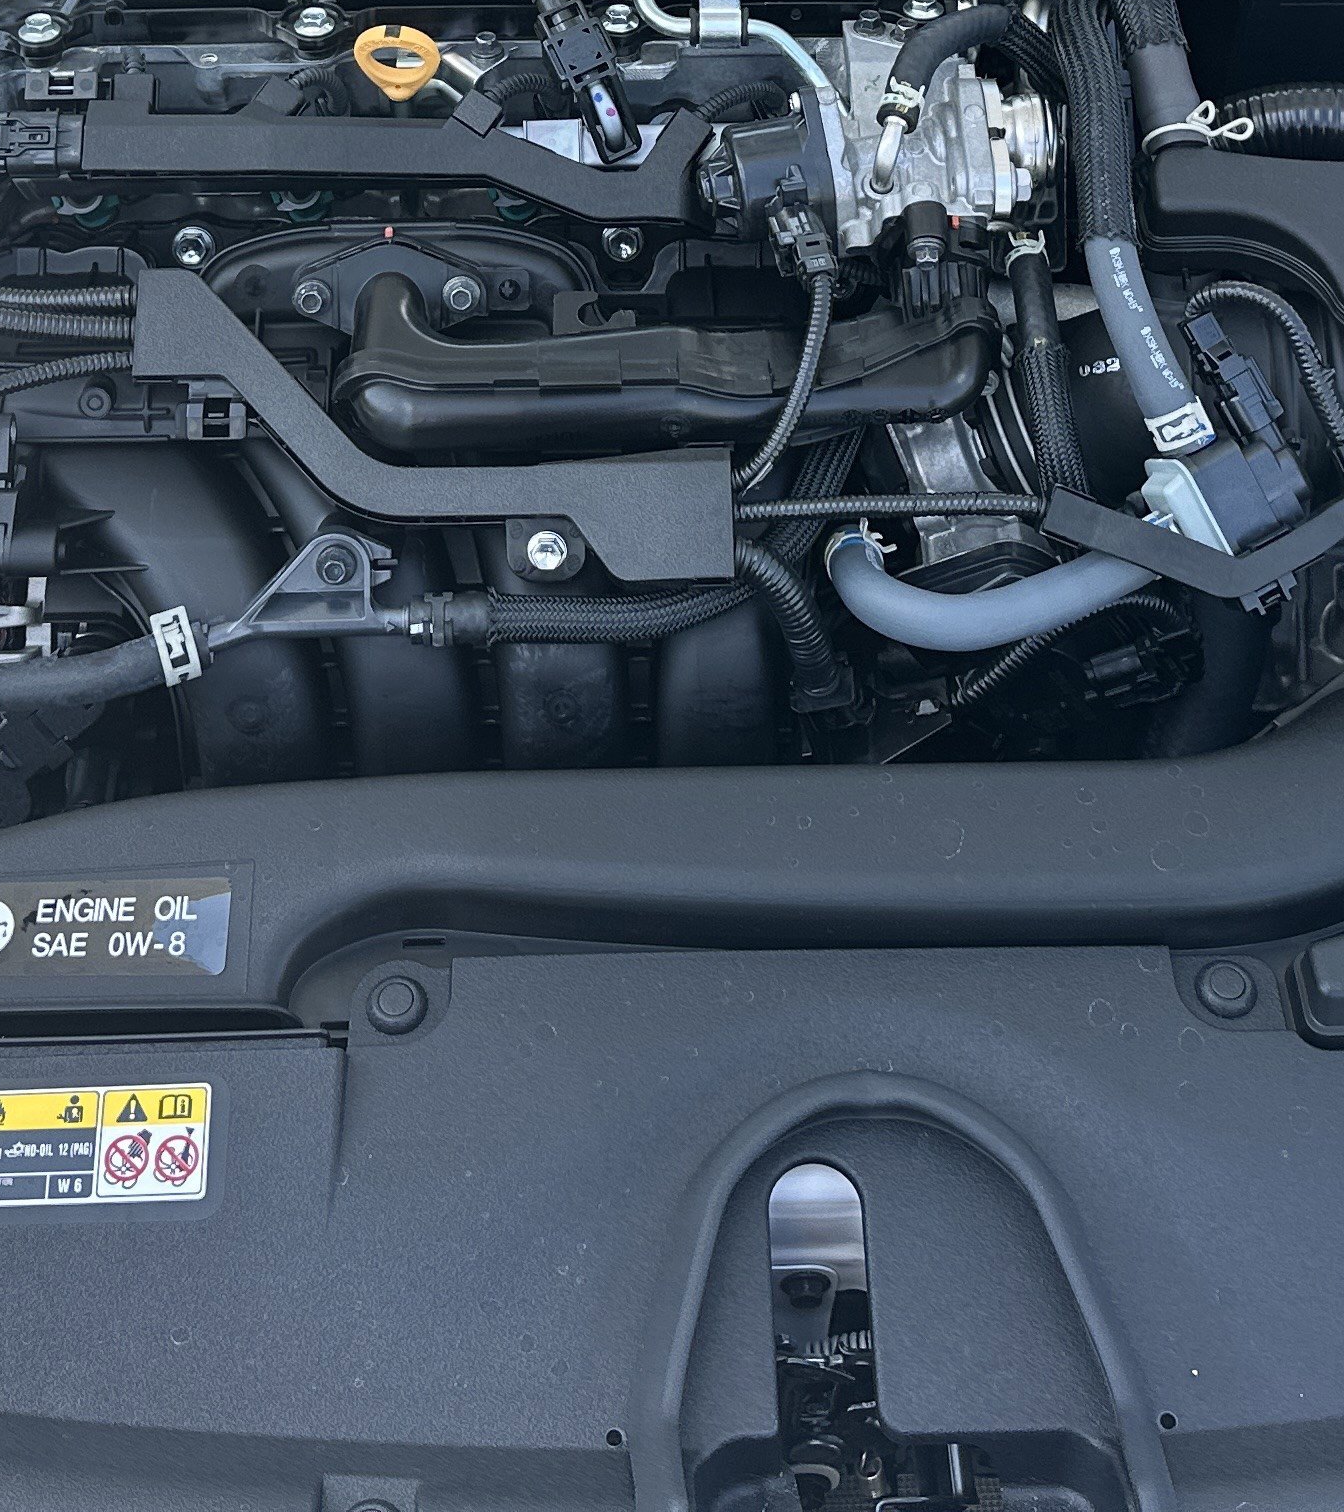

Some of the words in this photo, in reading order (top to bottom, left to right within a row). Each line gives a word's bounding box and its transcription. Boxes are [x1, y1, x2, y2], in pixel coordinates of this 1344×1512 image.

[36, 897, 137, 923] ENGINE
[154, 895, 197, 921] OIL
[31, 932, 89, 958] SAE
[108, 931, 186, 957] 0W-8
[23, 1143, 53, 1158] ND-OIL
[58, 1143, 68, 1156] 12
[70, 1142, 93, 1158] (PAG)
[57, 1178, 71, 1193] W
[73, 1177, 83, 1193] 6
